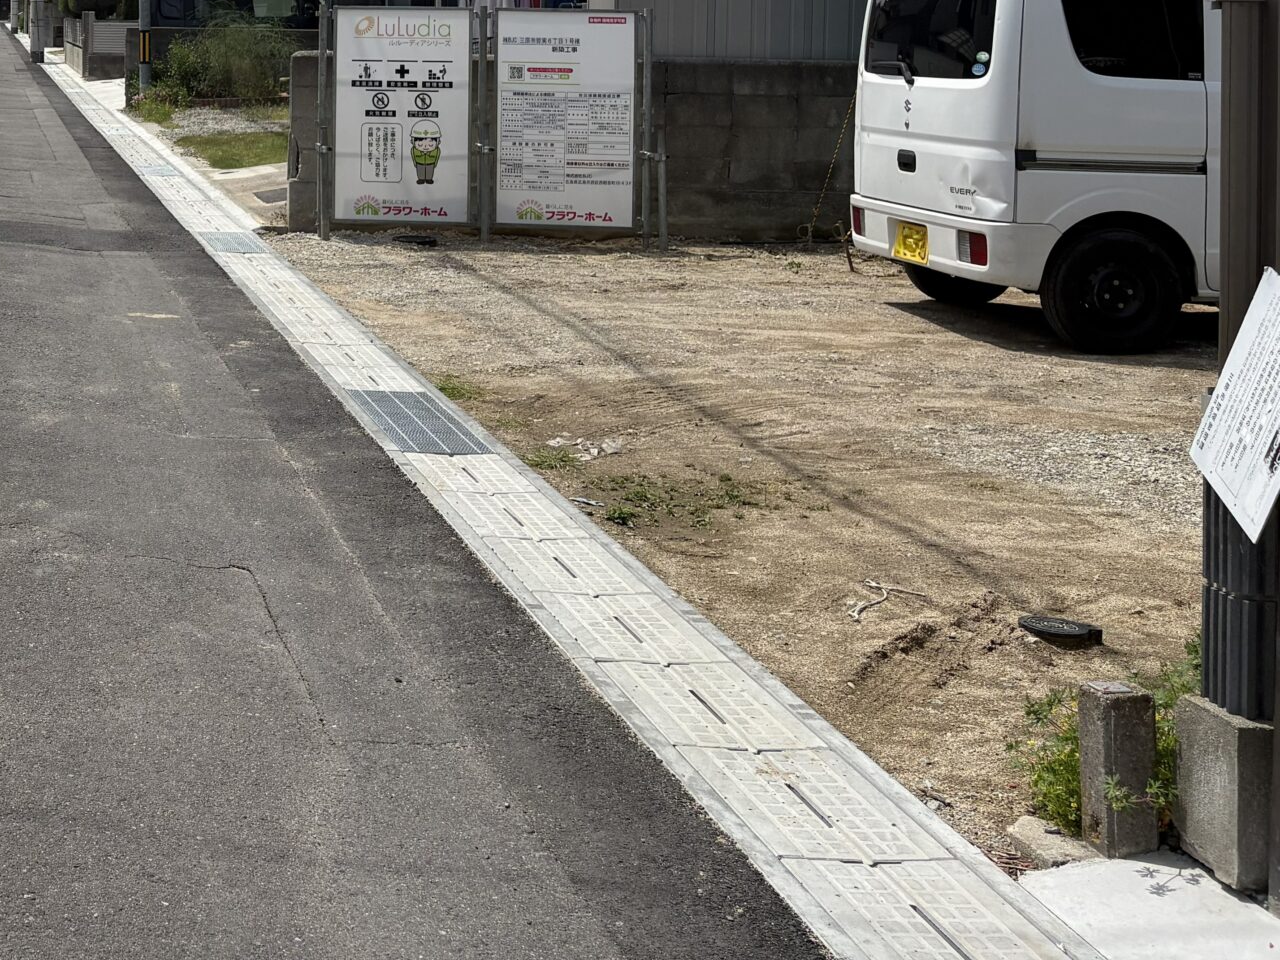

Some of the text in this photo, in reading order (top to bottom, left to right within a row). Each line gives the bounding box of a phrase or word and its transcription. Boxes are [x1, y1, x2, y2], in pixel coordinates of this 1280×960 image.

[376, 15, 451, 37] LuLudia
[388, 39, 451, 47] ルルーディアシリーズ
[949, 186, 977, 197] EVERY
[381, 205, 448, 217] フラワーホーム
[544, 210, 614, 223] フラワーホーム
